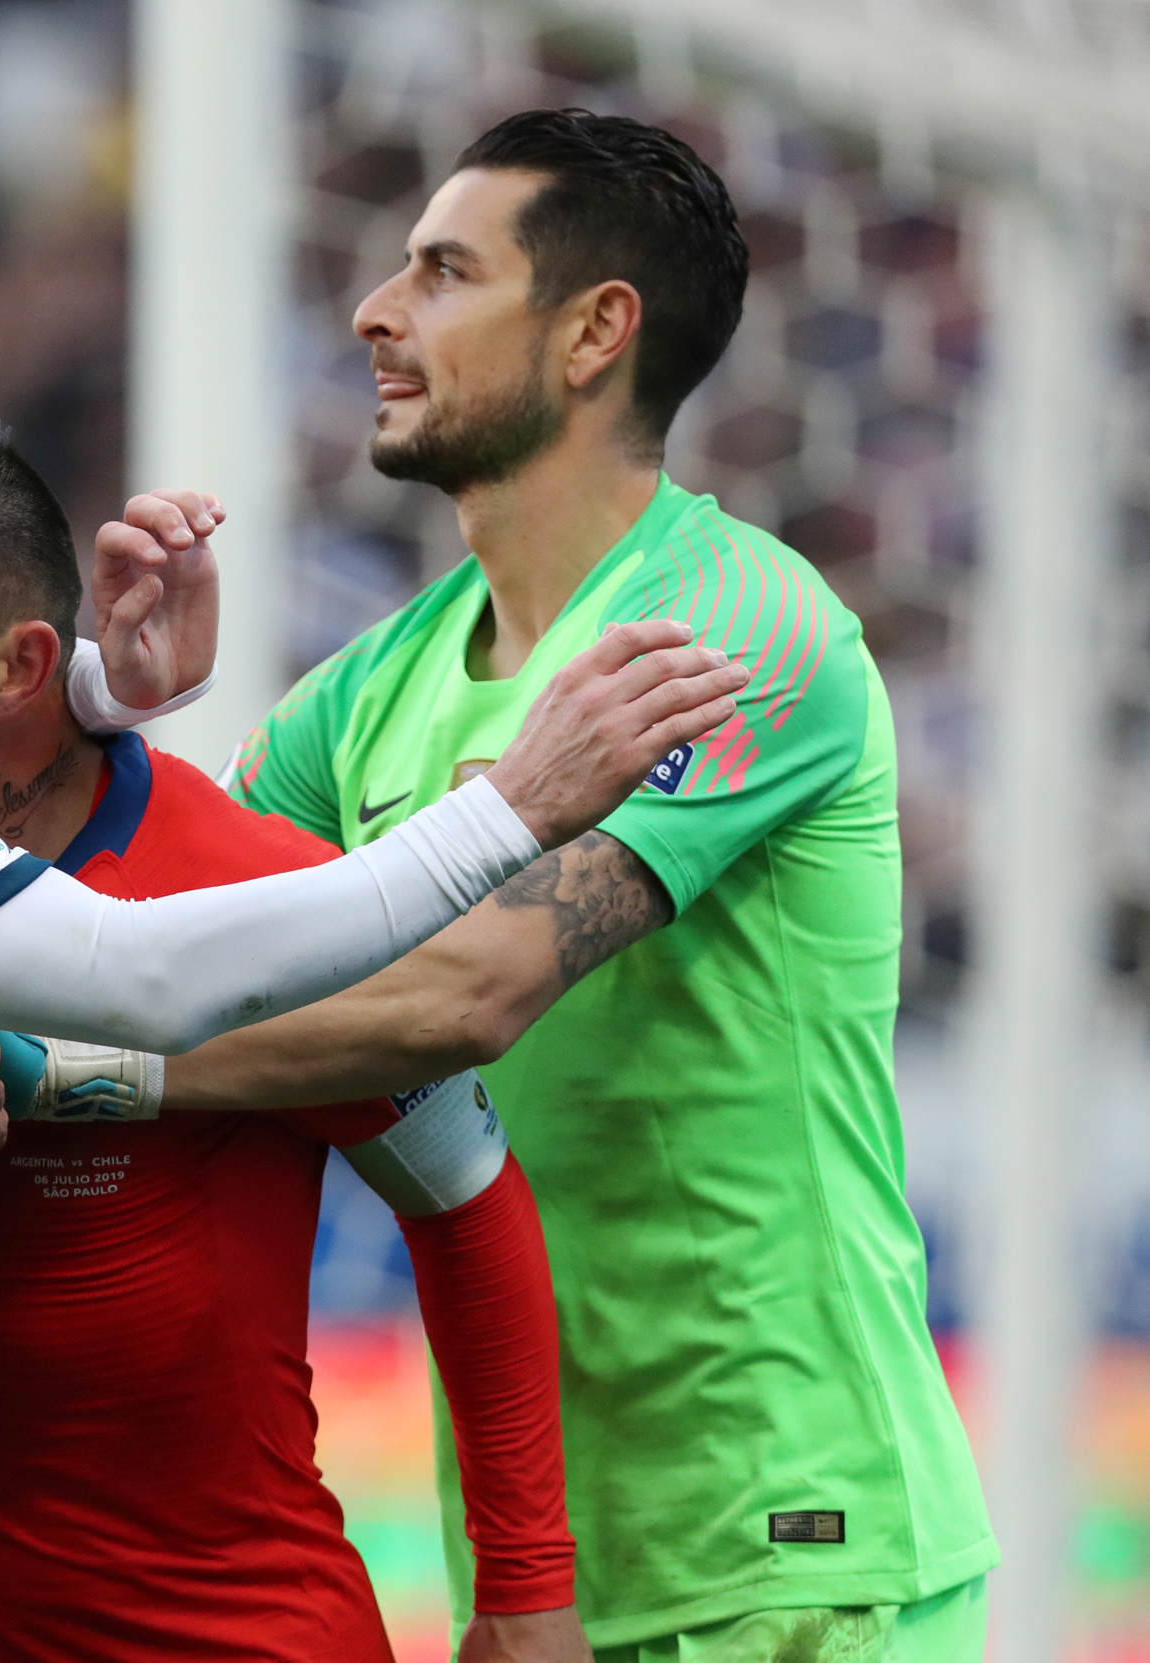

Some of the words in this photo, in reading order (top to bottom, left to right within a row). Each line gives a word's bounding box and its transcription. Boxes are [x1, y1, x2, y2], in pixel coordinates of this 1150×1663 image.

[10, 1156, 64, 1168] ARGENTINA
[92, 1155, 131, 1167] CHILE
[34, 1174, 49, 1185] 06
[52, 1174, 91, 1185] JULIO
[94, 1170, 125, 1183] 2019
[43, 1185, 70, 1198] SÃO
[73, 1184, 118, 1197] PAULO
